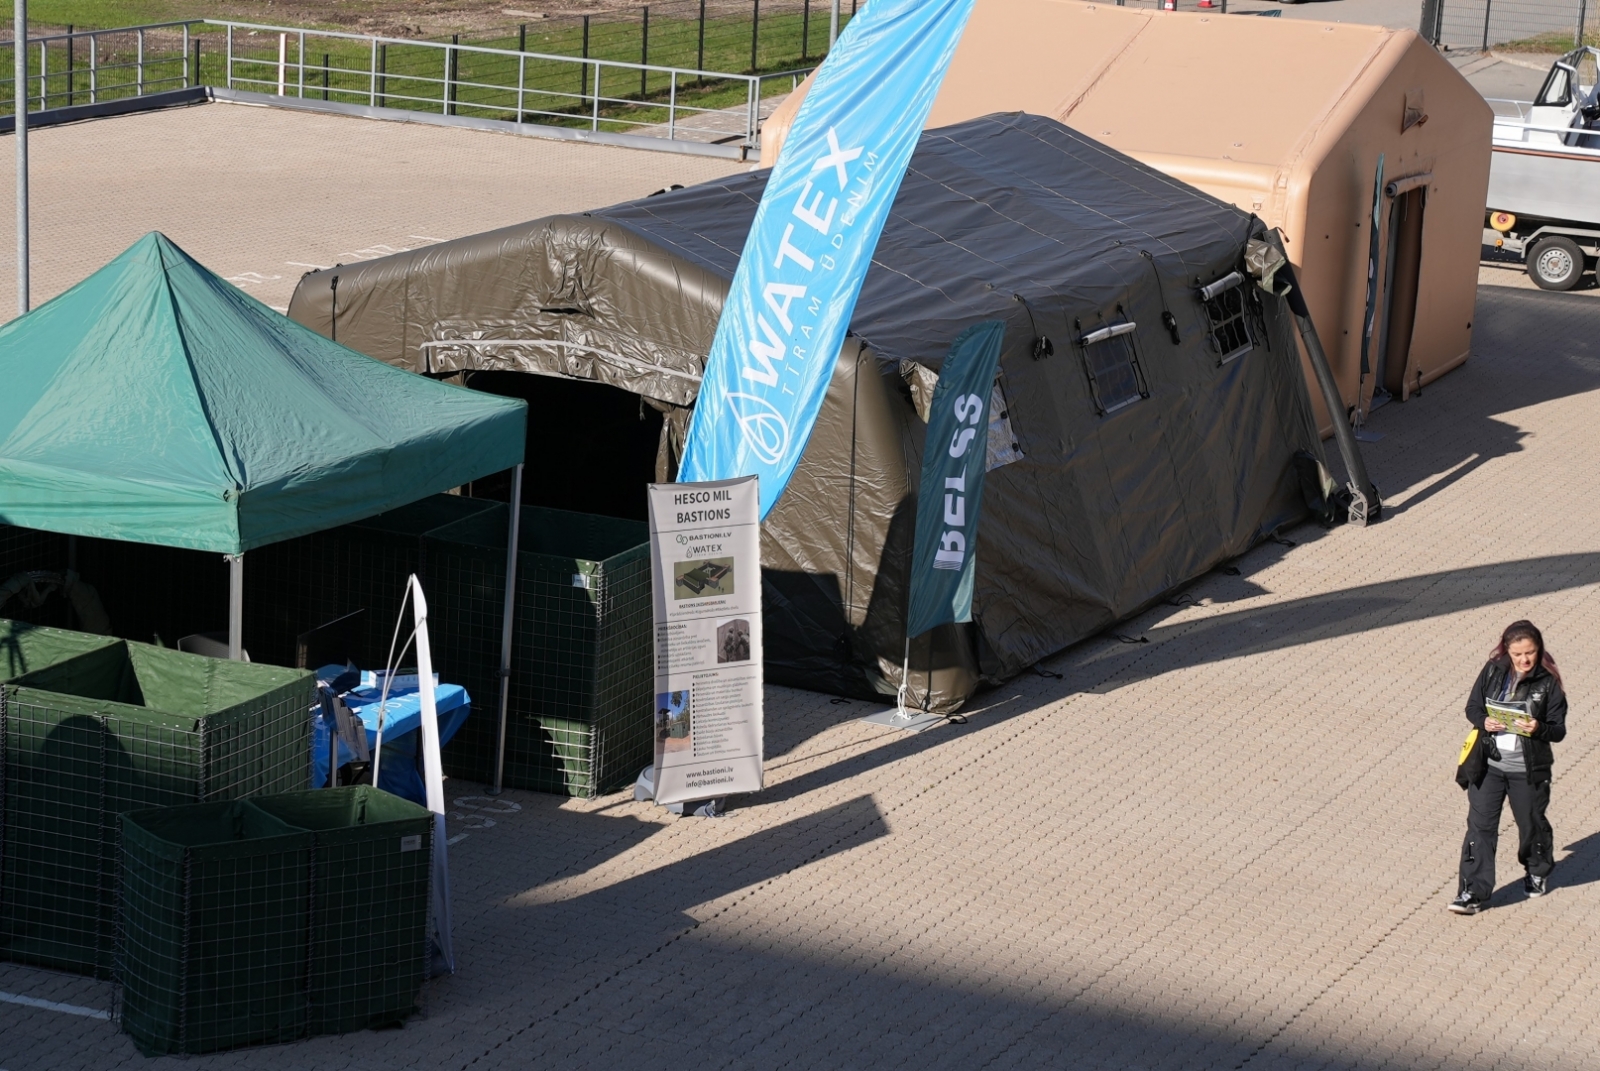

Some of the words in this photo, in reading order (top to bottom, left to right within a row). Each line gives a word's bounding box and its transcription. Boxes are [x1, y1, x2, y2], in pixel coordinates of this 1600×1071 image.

[741, 126, 865, 389] WATEX
[781, 295, 823, 398] TĪRAM
[819, 151, 880, 272] ŪDENIM
[674, 491, 711, 505] HESCO
[713, 489, 732, 502] MIL
[676, 508, 731, 524] BASTIONS
[688, 532, 732, 541] BASTIONI.LV
[692, 543, 723, 554] WATEX
[685, 766, 734, 779] www.bastioni.lv
[685, 775, 735, 788] info@bastioni.lv
